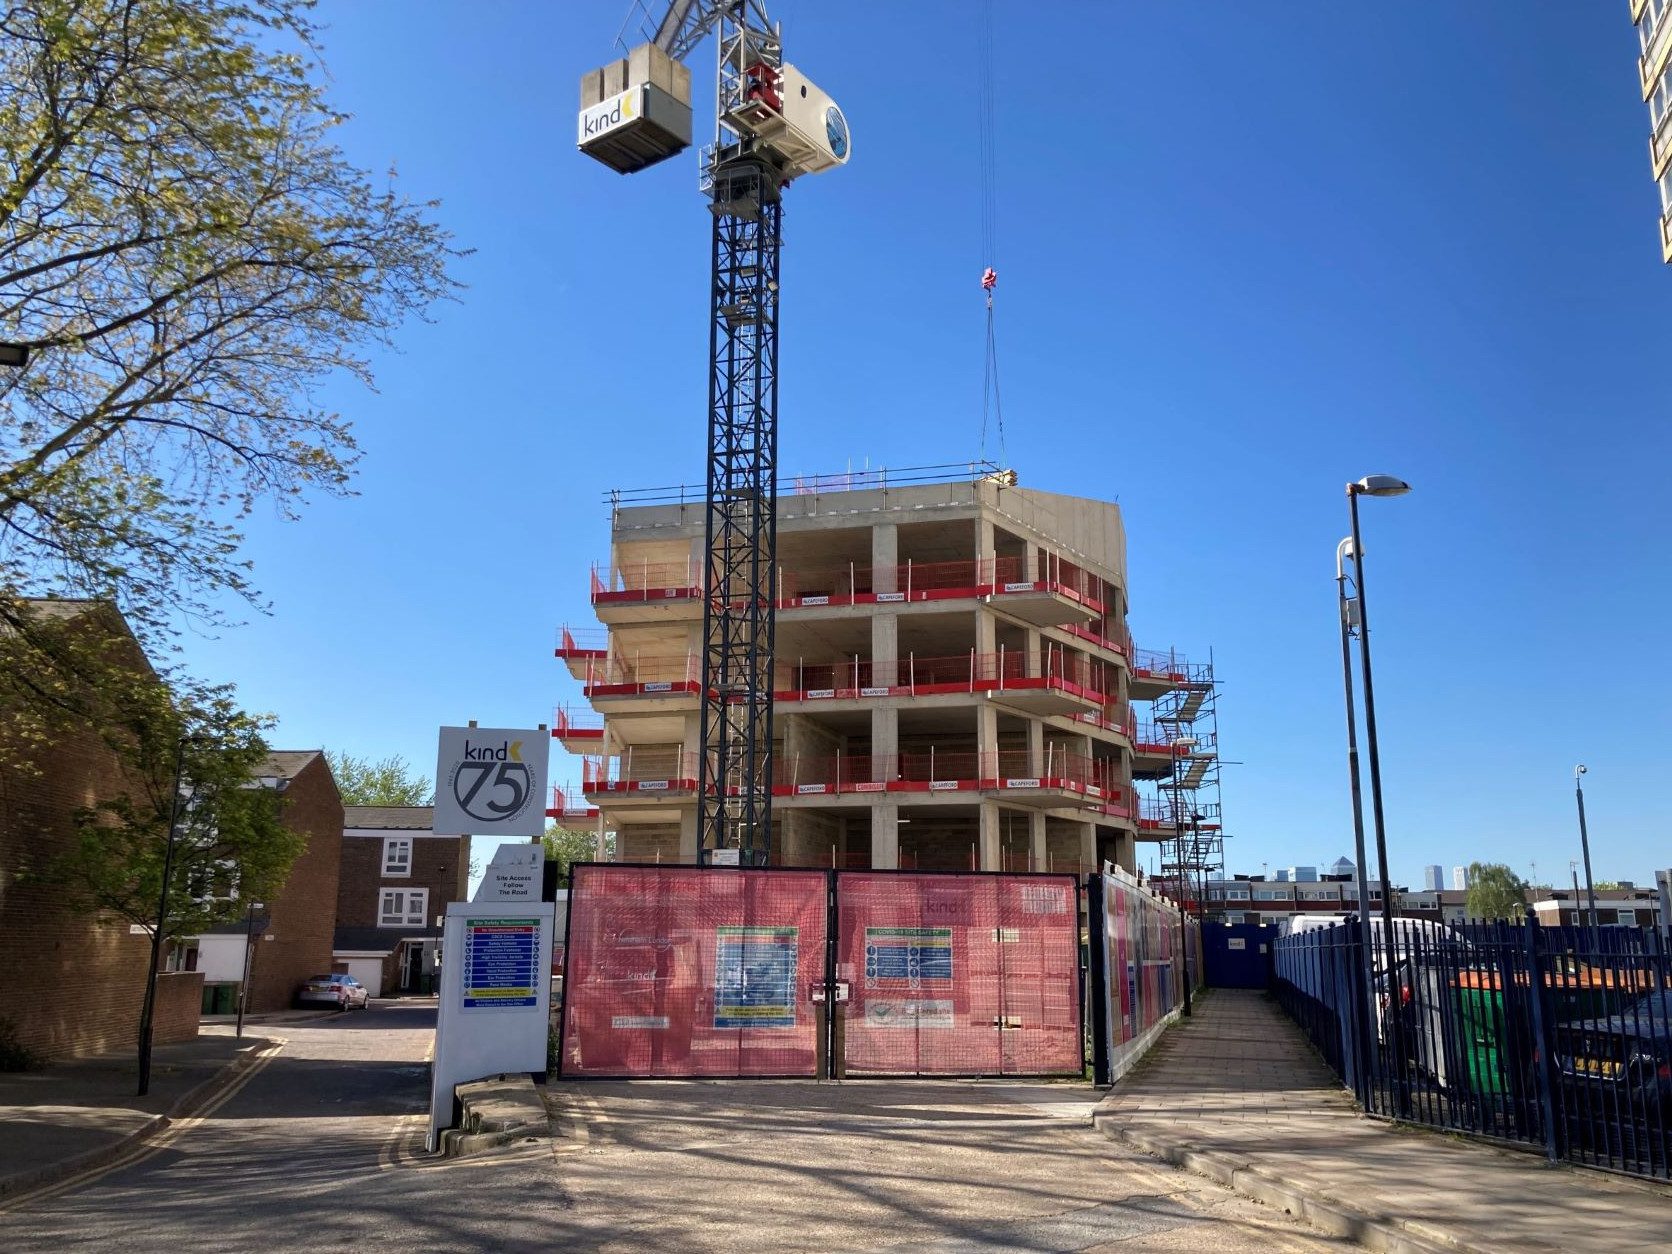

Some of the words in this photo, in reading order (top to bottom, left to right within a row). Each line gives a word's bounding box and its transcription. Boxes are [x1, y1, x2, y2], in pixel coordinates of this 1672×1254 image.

[584, 99, 621, 137] kind
[465, 740, 507, 761] kind
[457, 761, 527, 817] 75
[926, 899, 957, 913] kind
[627, 970, 651, 980] kind
